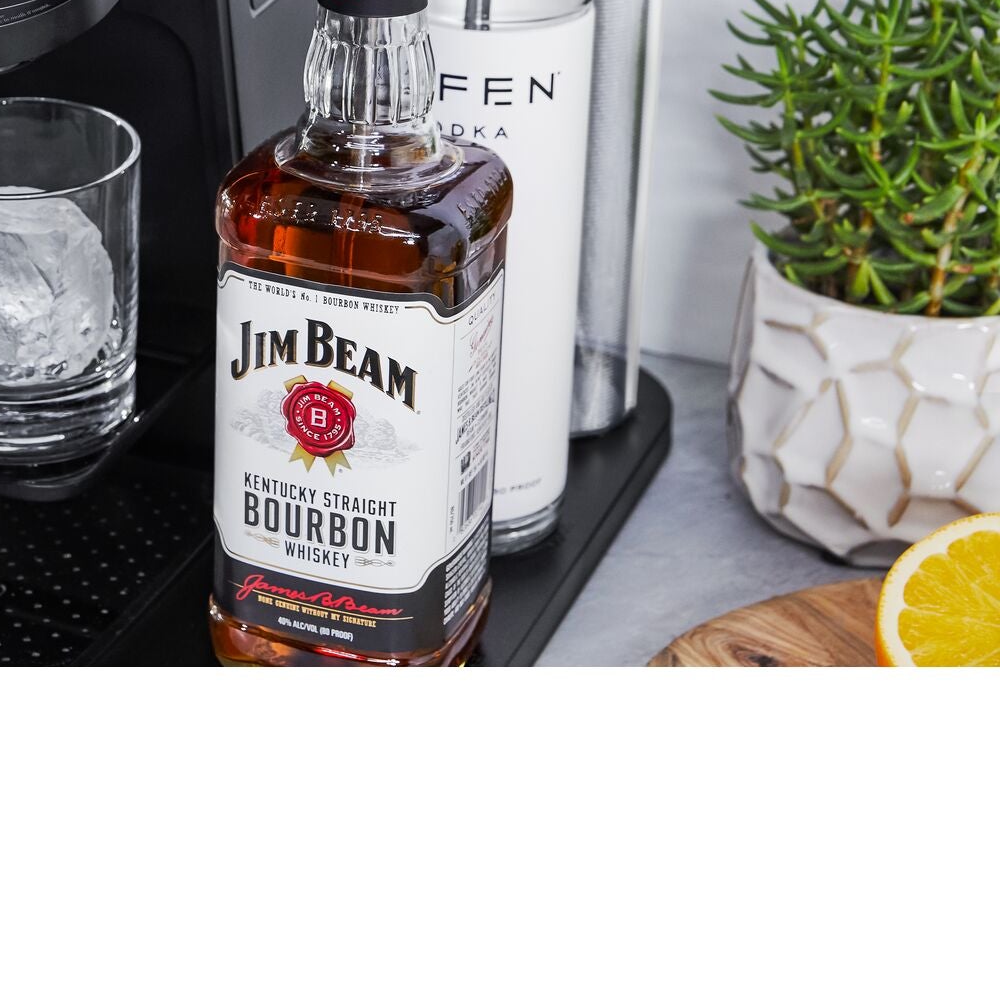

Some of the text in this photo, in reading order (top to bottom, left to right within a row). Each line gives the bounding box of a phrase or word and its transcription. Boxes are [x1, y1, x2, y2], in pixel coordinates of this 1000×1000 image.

[248, 281, 262, 292] THE
[265, 284, 296, 299] WORLD'S
[323, 296, 359, 310] BOURBON
[363, 302, 399, 315] WHISKEY
[297, 394, 341, 416] JIM BEAM
[310, 407, 327, 428] B
[295, 416, 342, 441] SINCE 1795
[244, 472, 397, 517] KENTUCKY STRAIGHT
[244, 490, 396, 555] BOURBON
[285, 540, 350, 569] WHISKEY
[236, 574, 306, 601] James
[258, 595, 377, 628] NONE GENUINE WITHOUT MY SIGNATURE
[277, 616, 292, 627] 40%
[293, 618, 318, 634] ALC/VOL
[331, 629, 353, 642] PROOF)
